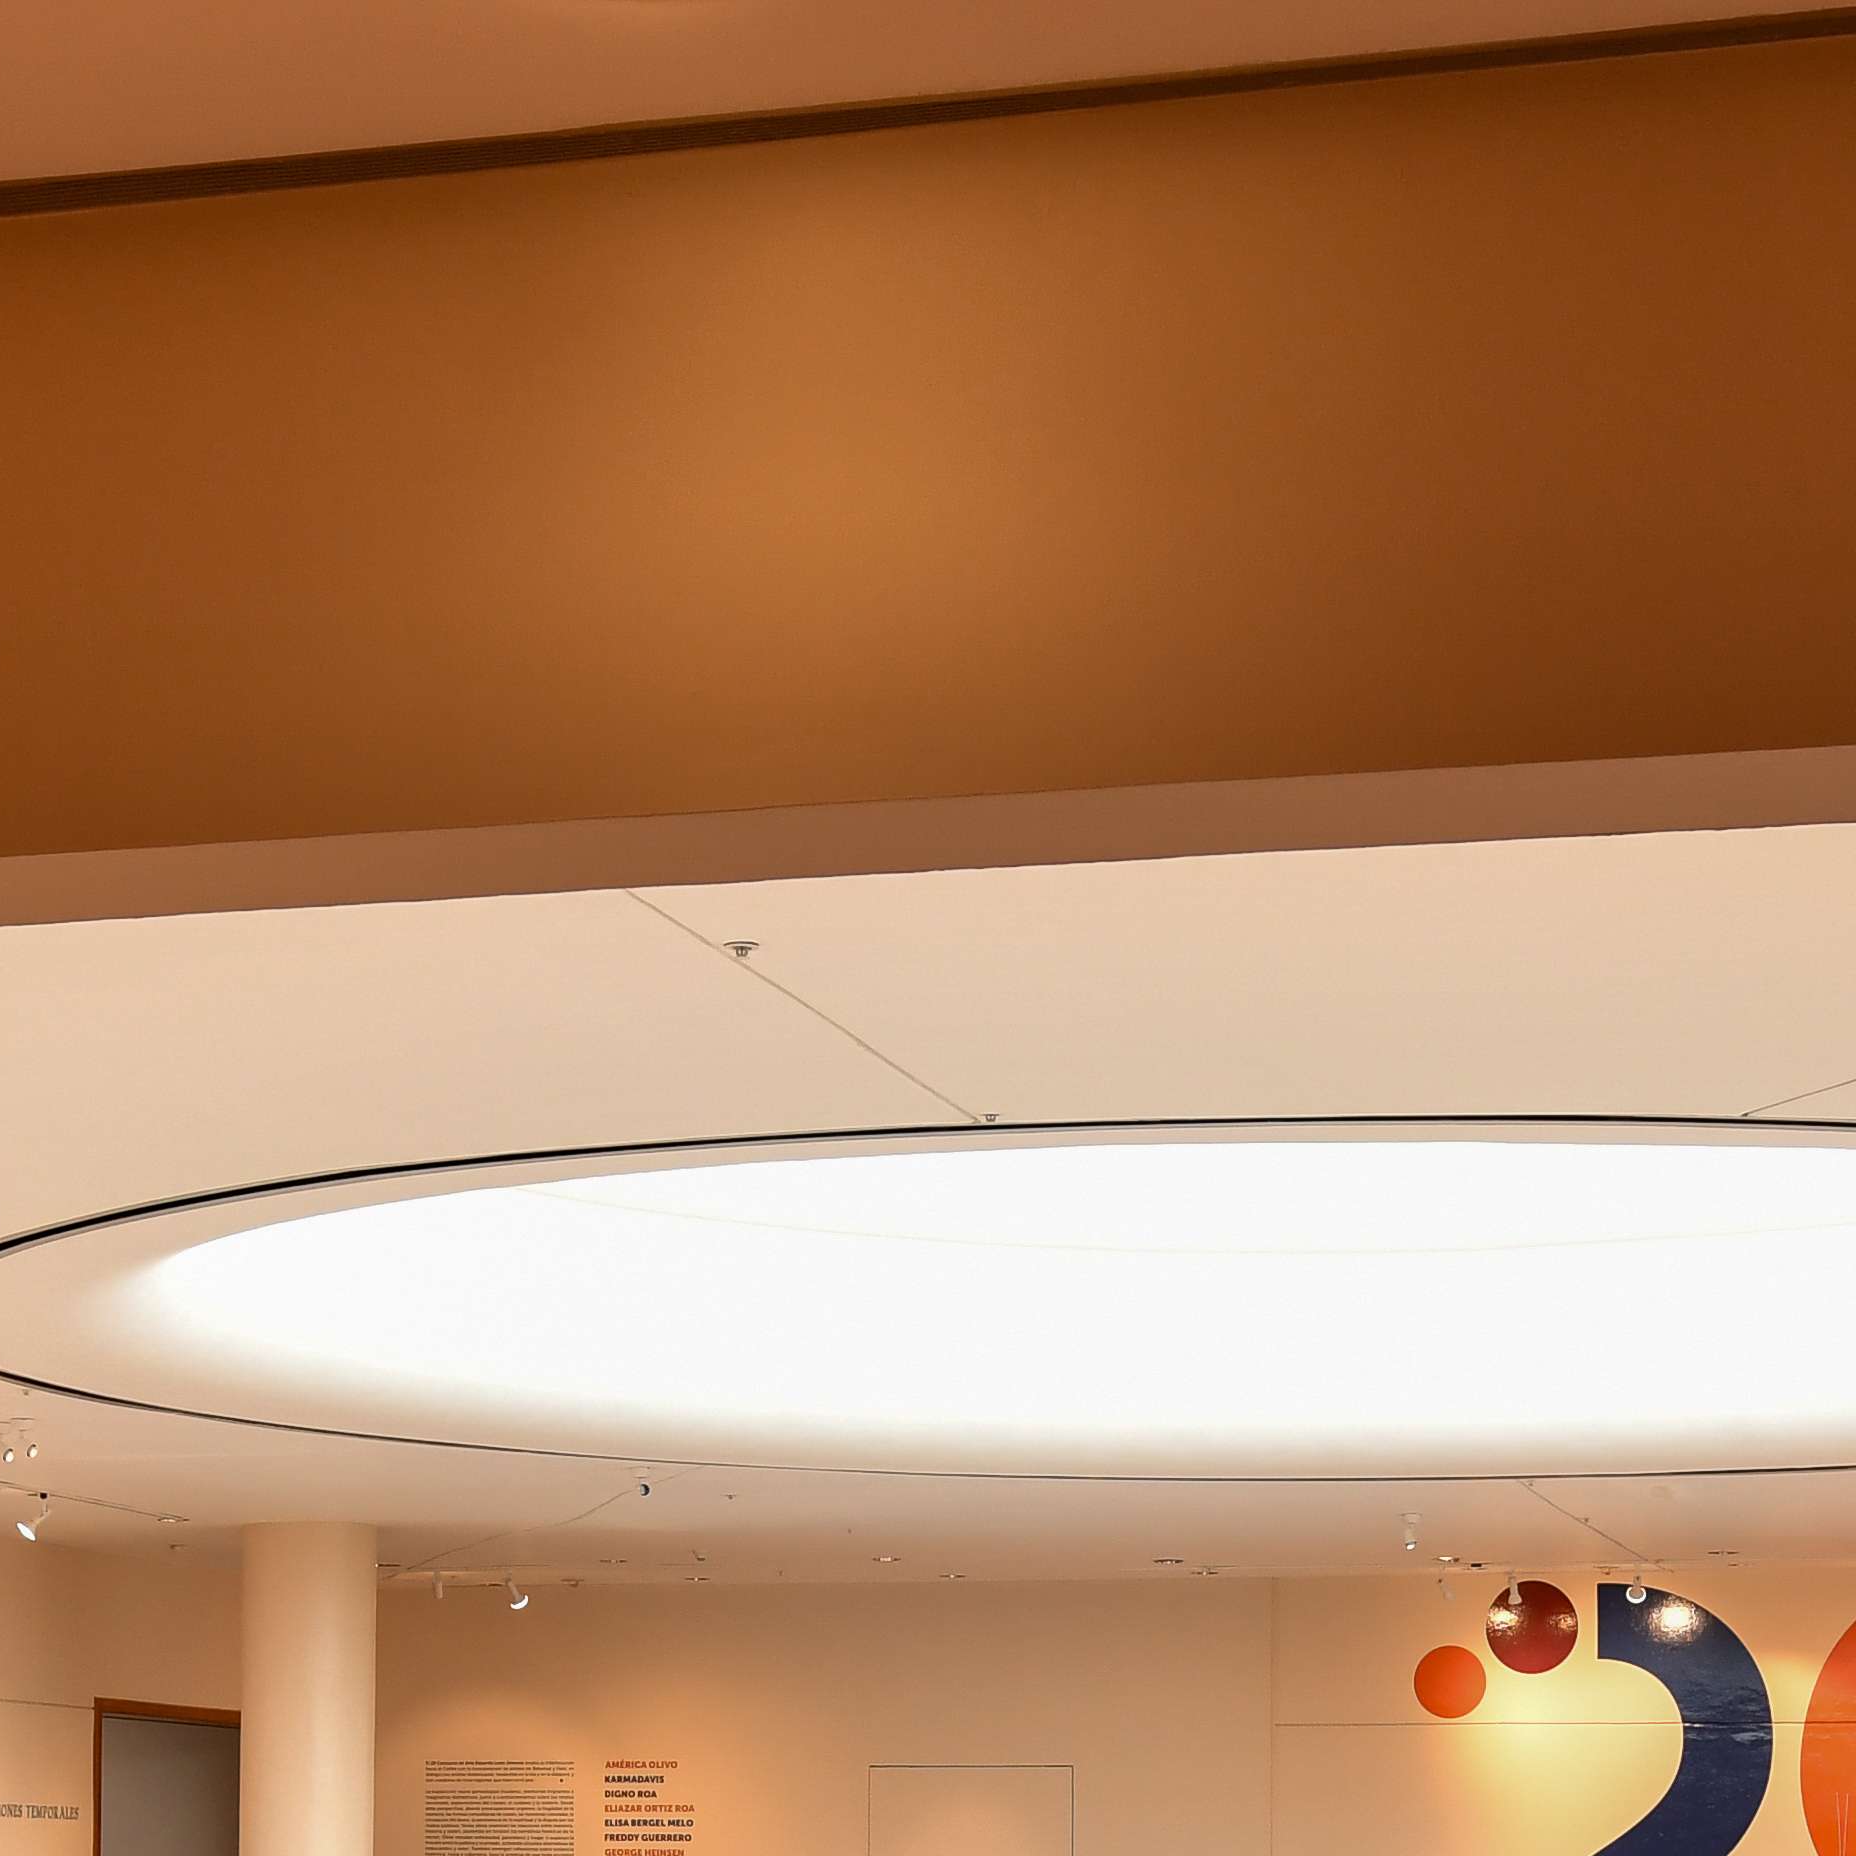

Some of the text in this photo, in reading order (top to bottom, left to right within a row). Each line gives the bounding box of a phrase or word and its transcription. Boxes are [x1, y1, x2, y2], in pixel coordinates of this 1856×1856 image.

[605, 1759, 677, 1769] AMÉRICA OLIVO
[604, 1776, 664, 1784] KARMADAVIS
[605, 1790, 658, 1799] DIGNO ROA
[26, 1804, 79, 1820] TEMPORALES
[644, 1805, 673, 1813] ORTIZ
[675, 1805, 695, 1813] ROA
[605, 1819, 694, 1828] ELISA BERGEL MELO
[604, 1834, 692, 1843] FREDDY GUERRERO
[605, 1849, 684, 1856] GEORGE HEINSEN
